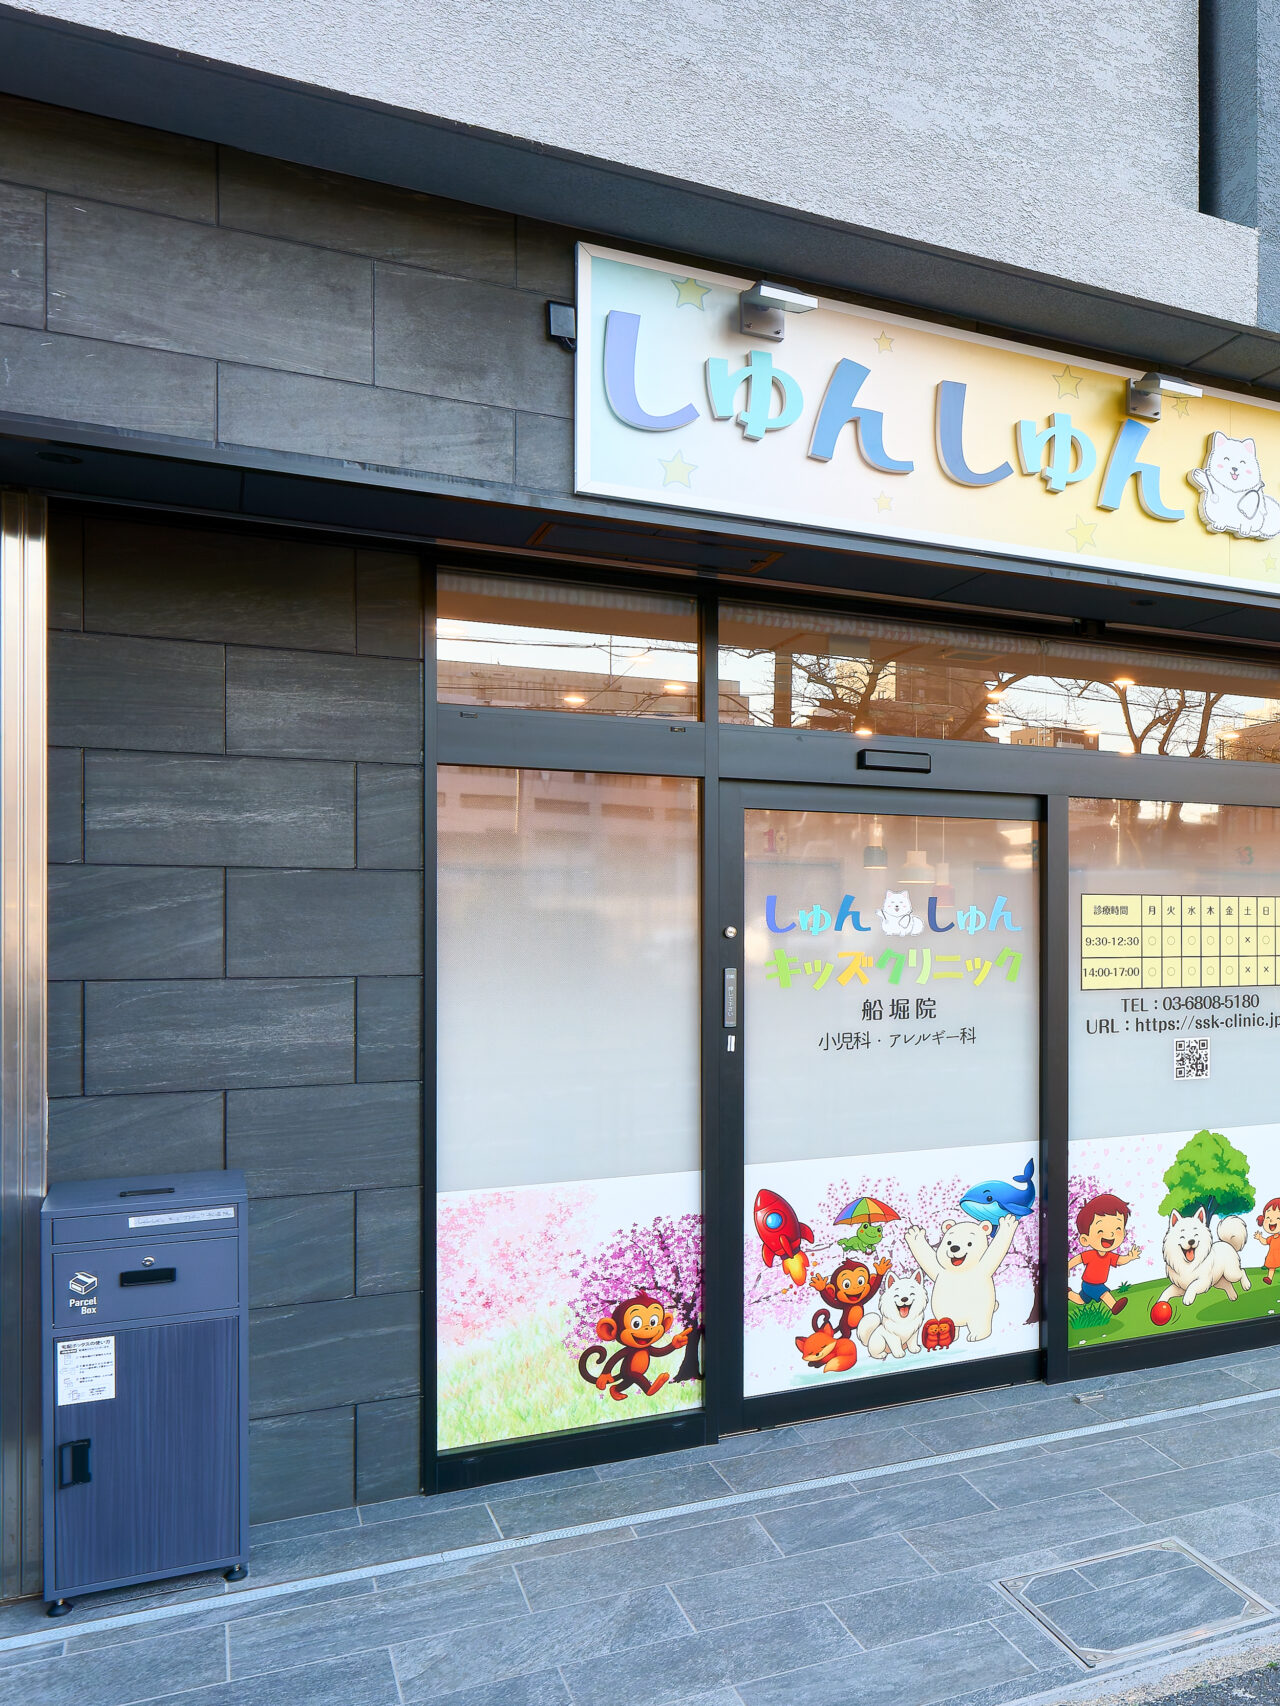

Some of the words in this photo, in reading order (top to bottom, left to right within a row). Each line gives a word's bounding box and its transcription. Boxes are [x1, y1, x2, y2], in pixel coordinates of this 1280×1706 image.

[765, 894, 871, 935] しゅん
[927, 895, 1023, 935] しゅん
[1093, 905, 1129, 916] 診療時間
[1148, 906, 1156, 916] 月
[1166, 906, 1176, 916] 火
[1187, 906, 1196, 916] 水
[1206, 906, 1215, 916] 木
[1225, 906, 1234, 916] 金
[1244, 906, 1252, 916] 土
[1262, 906, 1270, 916] 日
[1085, 936, 1139, 946] 9:30-12:30
[764, 946, 1023, 991] キッズクリニック
[1082, 967, 1140, 977] 14:00-17:00
[861, 997, 937, 1021] 船堀院
[818, 1026, 977, 1051] 小児科・アレルギー科
[69, 1296, 97, 1308] Parcel
[81, 1306, 97, 1315] Box
